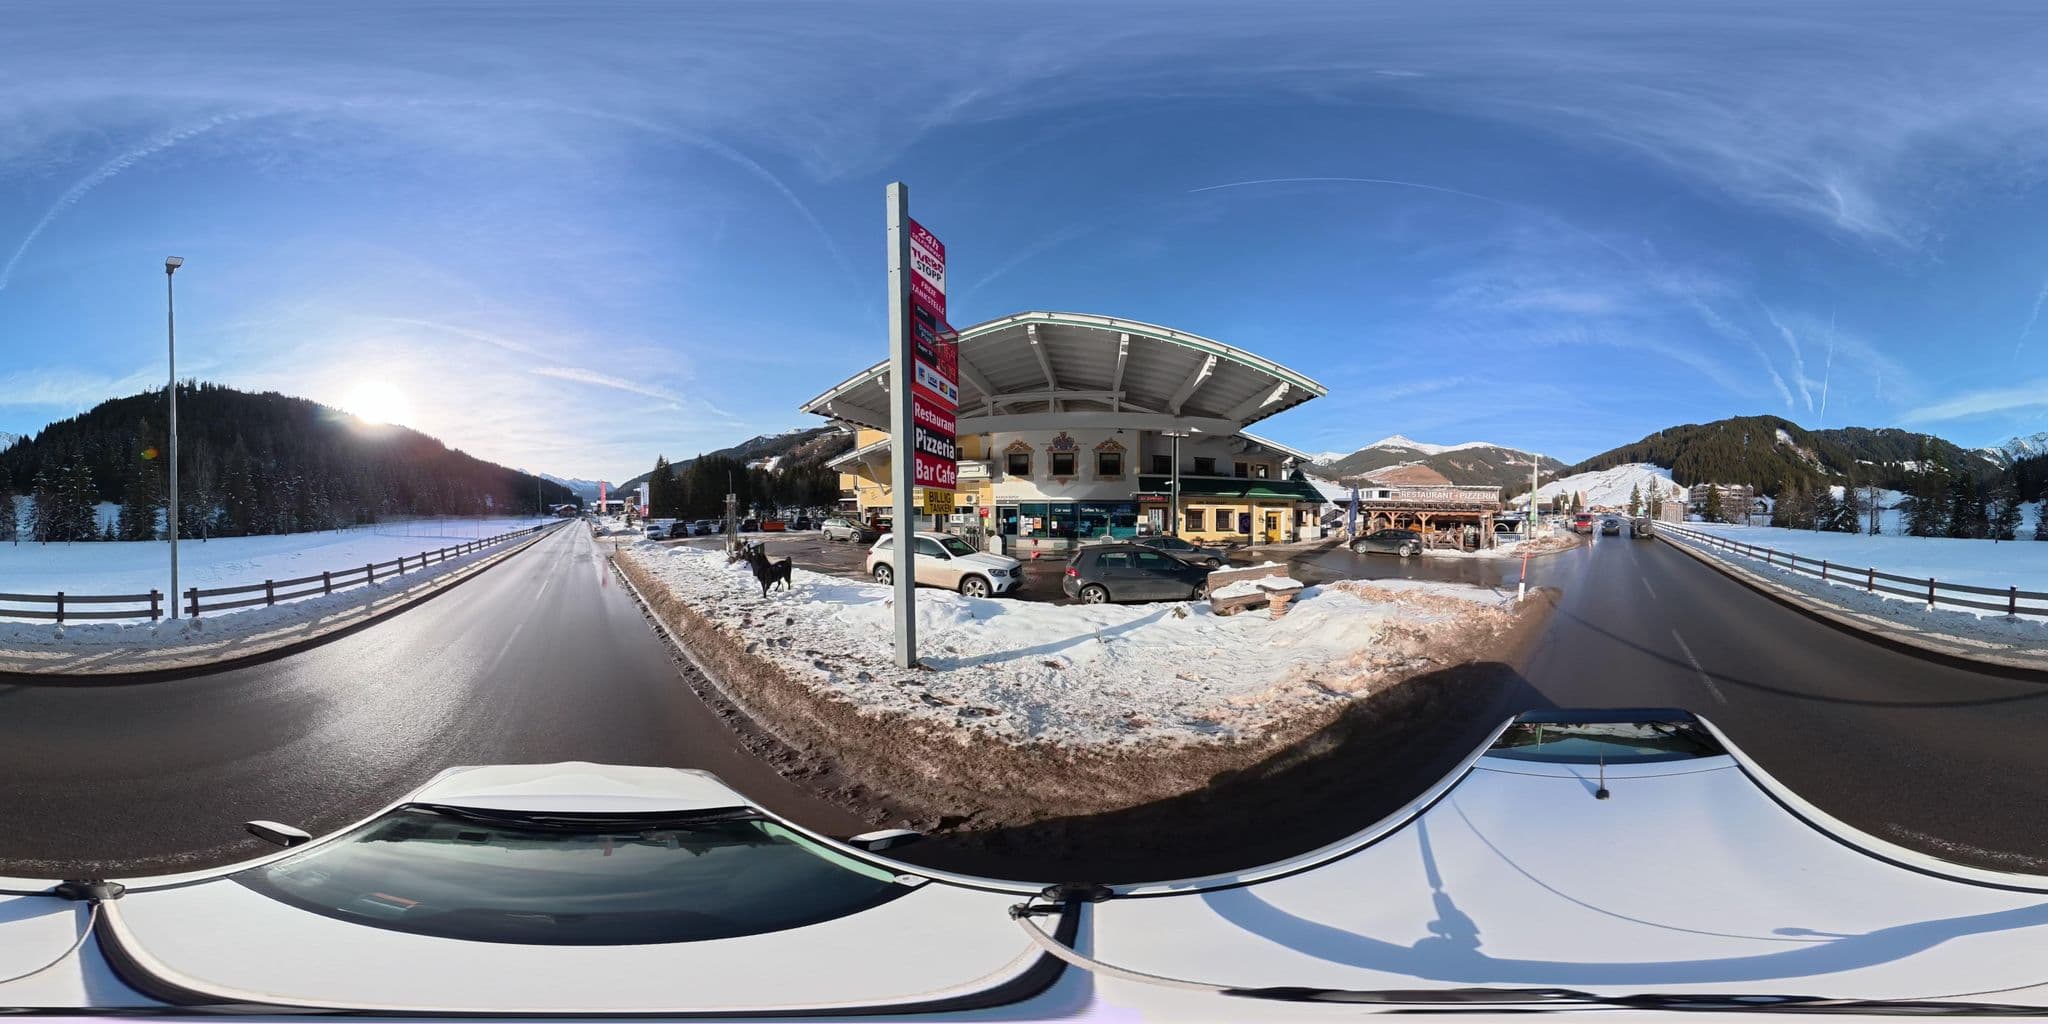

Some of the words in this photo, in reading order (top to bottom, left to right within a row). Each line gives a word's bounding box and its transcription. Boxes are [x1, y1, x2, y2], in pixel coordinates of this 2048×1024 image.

[918, 228, 940, 251] 24h
[916, 260, 942, 281] STOPP
[912, 284, 945, 315] TANKSTELLE
[914, 402, 955, 434] Restaurant
[915, 427, 955, 459] Pizzeria
[915, 458, 934, 481] Bar
[936, 463, 955, 485] Cafe
[928, 491, 951, 503] BILLIG
[1401, 491, 1453, 500] RESTAURANT
[1459, 491, 1497, 500] PIZZERIA
[929, 503, 952, 513] TANKEN
